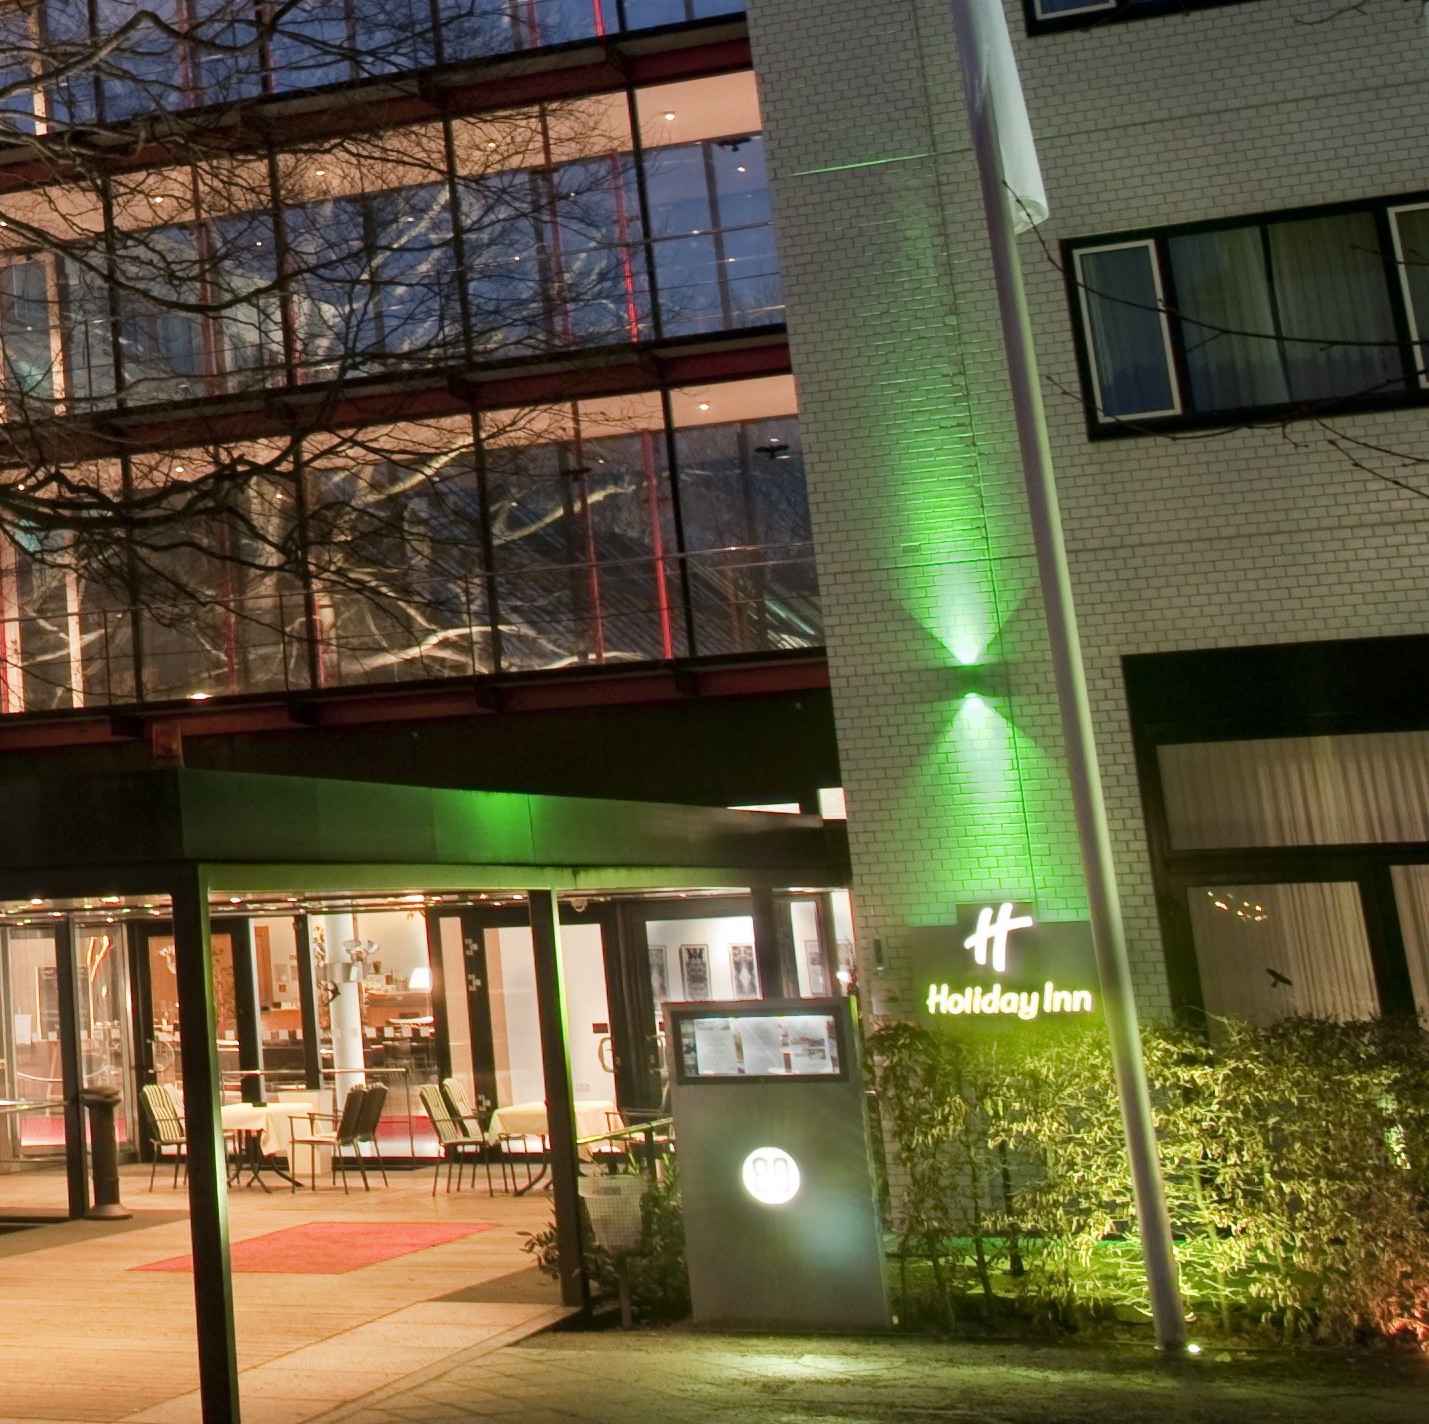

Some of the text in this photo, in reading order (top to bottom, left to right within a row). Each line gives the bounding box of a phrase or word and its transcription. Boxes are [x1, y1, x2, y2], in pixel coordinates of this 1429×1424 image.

[925, 980, 1093, 1021] Holiday Inn
[752, 1156, 791, 1194] 80
